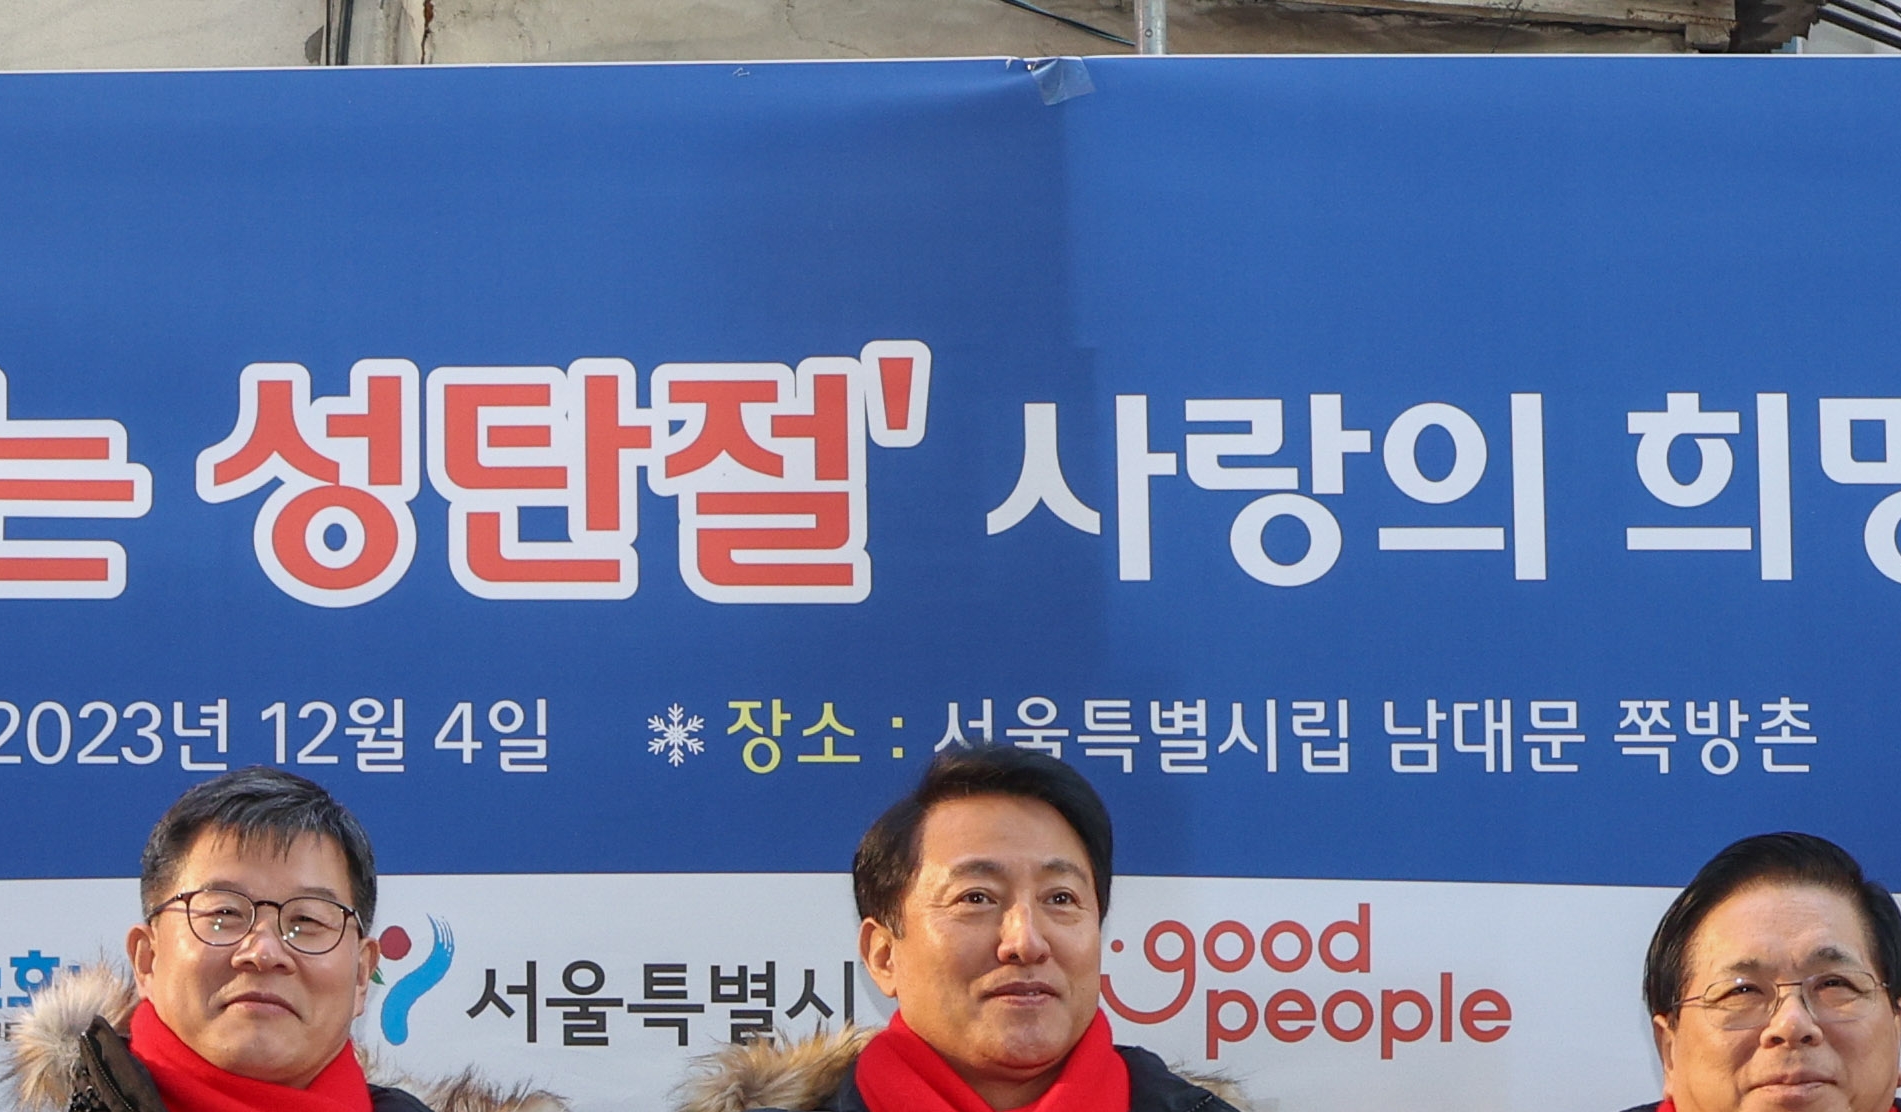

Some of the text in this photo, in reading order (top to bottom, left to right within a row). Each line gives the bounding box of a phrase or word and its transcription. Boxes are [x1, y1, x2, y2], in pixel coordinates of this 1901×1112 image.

[196, 340, 931, 607] 성탄절'
[987, 393, 1546, 586] 사랑의
[262, 698, 404, 772] 12월
[435, 699, 547, 772] 4일
[728, 699, 860, 773] 장소
[935, 697, 1348, 773] 서울특별시립
[1384, 700, 1585, 772] 남대문
[1614, 697, 1816, 774] 쪽방촌
[466, 960, 855, 1047] 서울특별시
[1100, 903, 1371, 1025] good
[1206, 972, 1511, 1060] people
